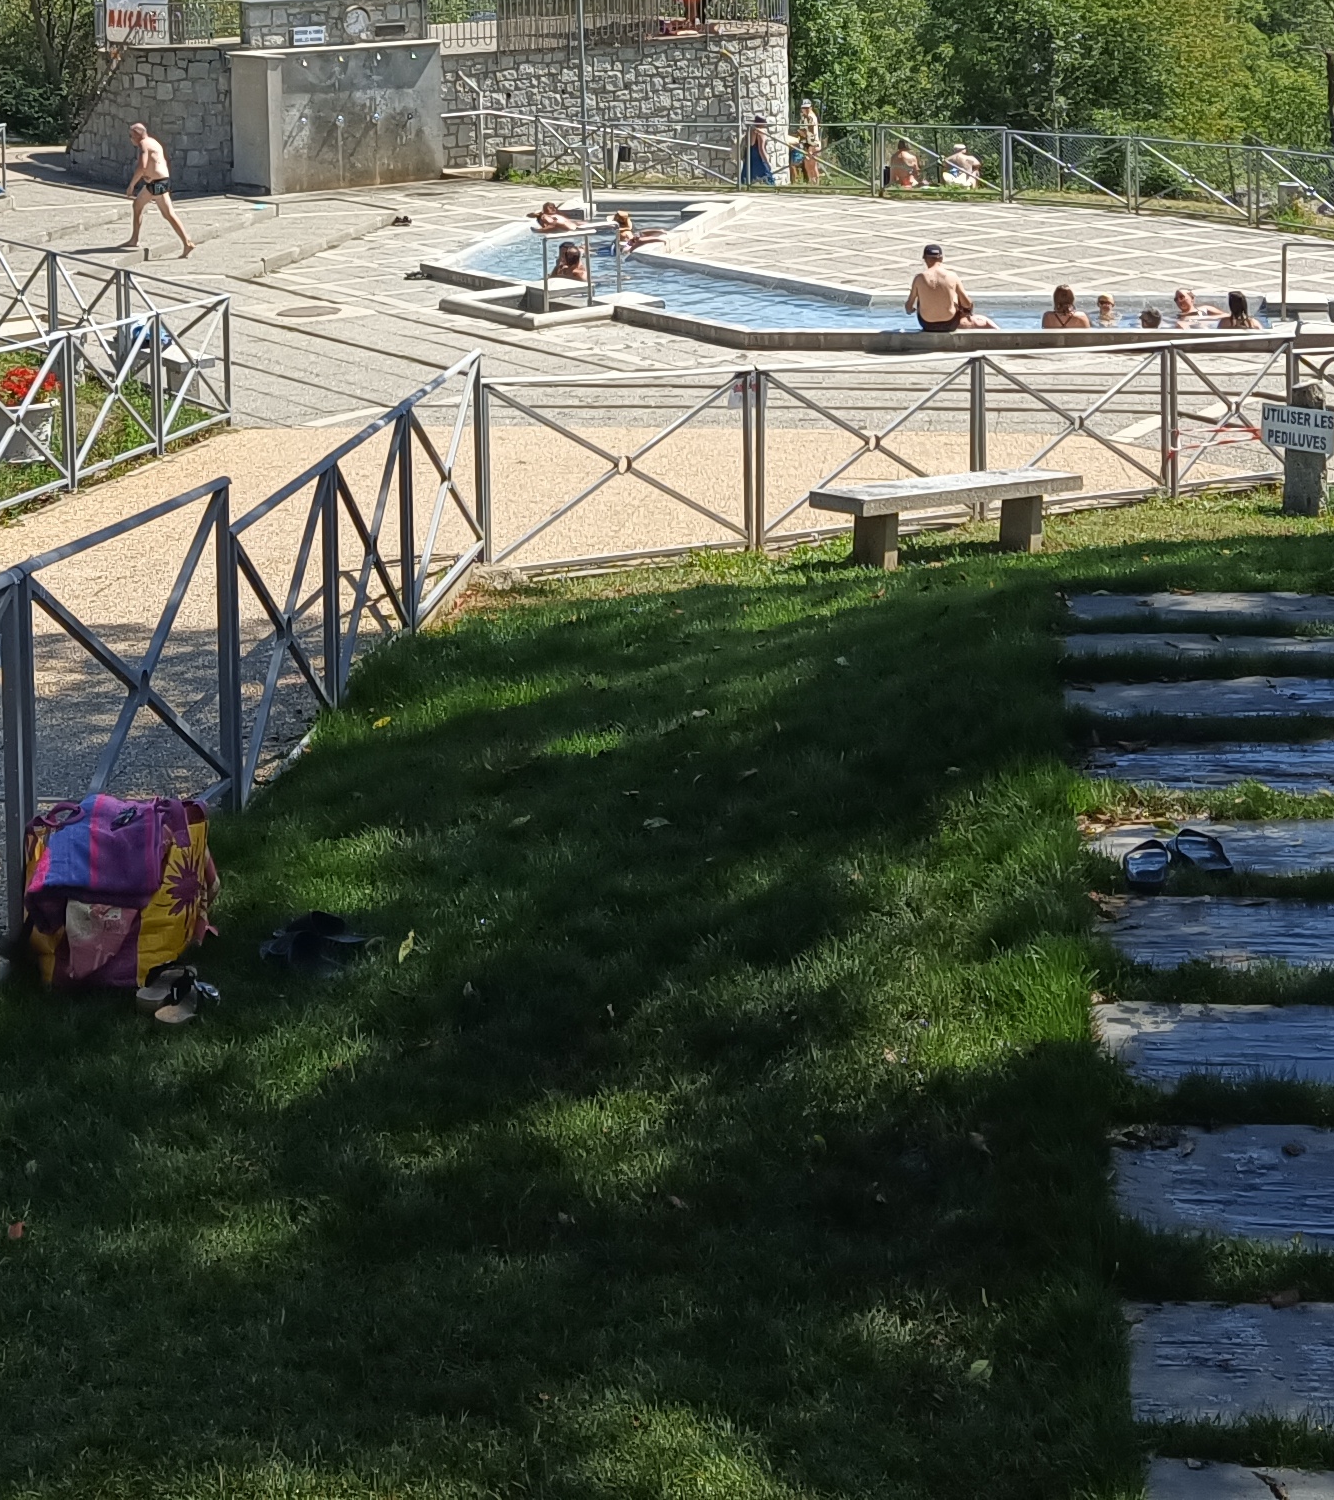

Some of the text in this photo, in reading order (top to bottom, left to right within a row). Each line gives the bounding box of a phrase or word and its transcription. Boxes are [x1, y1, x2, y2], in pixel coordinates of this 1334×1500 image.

[1263, 407, 1334, 429] UTILISER LES
[1268, 429, 1327, 450] PEDILUVES
